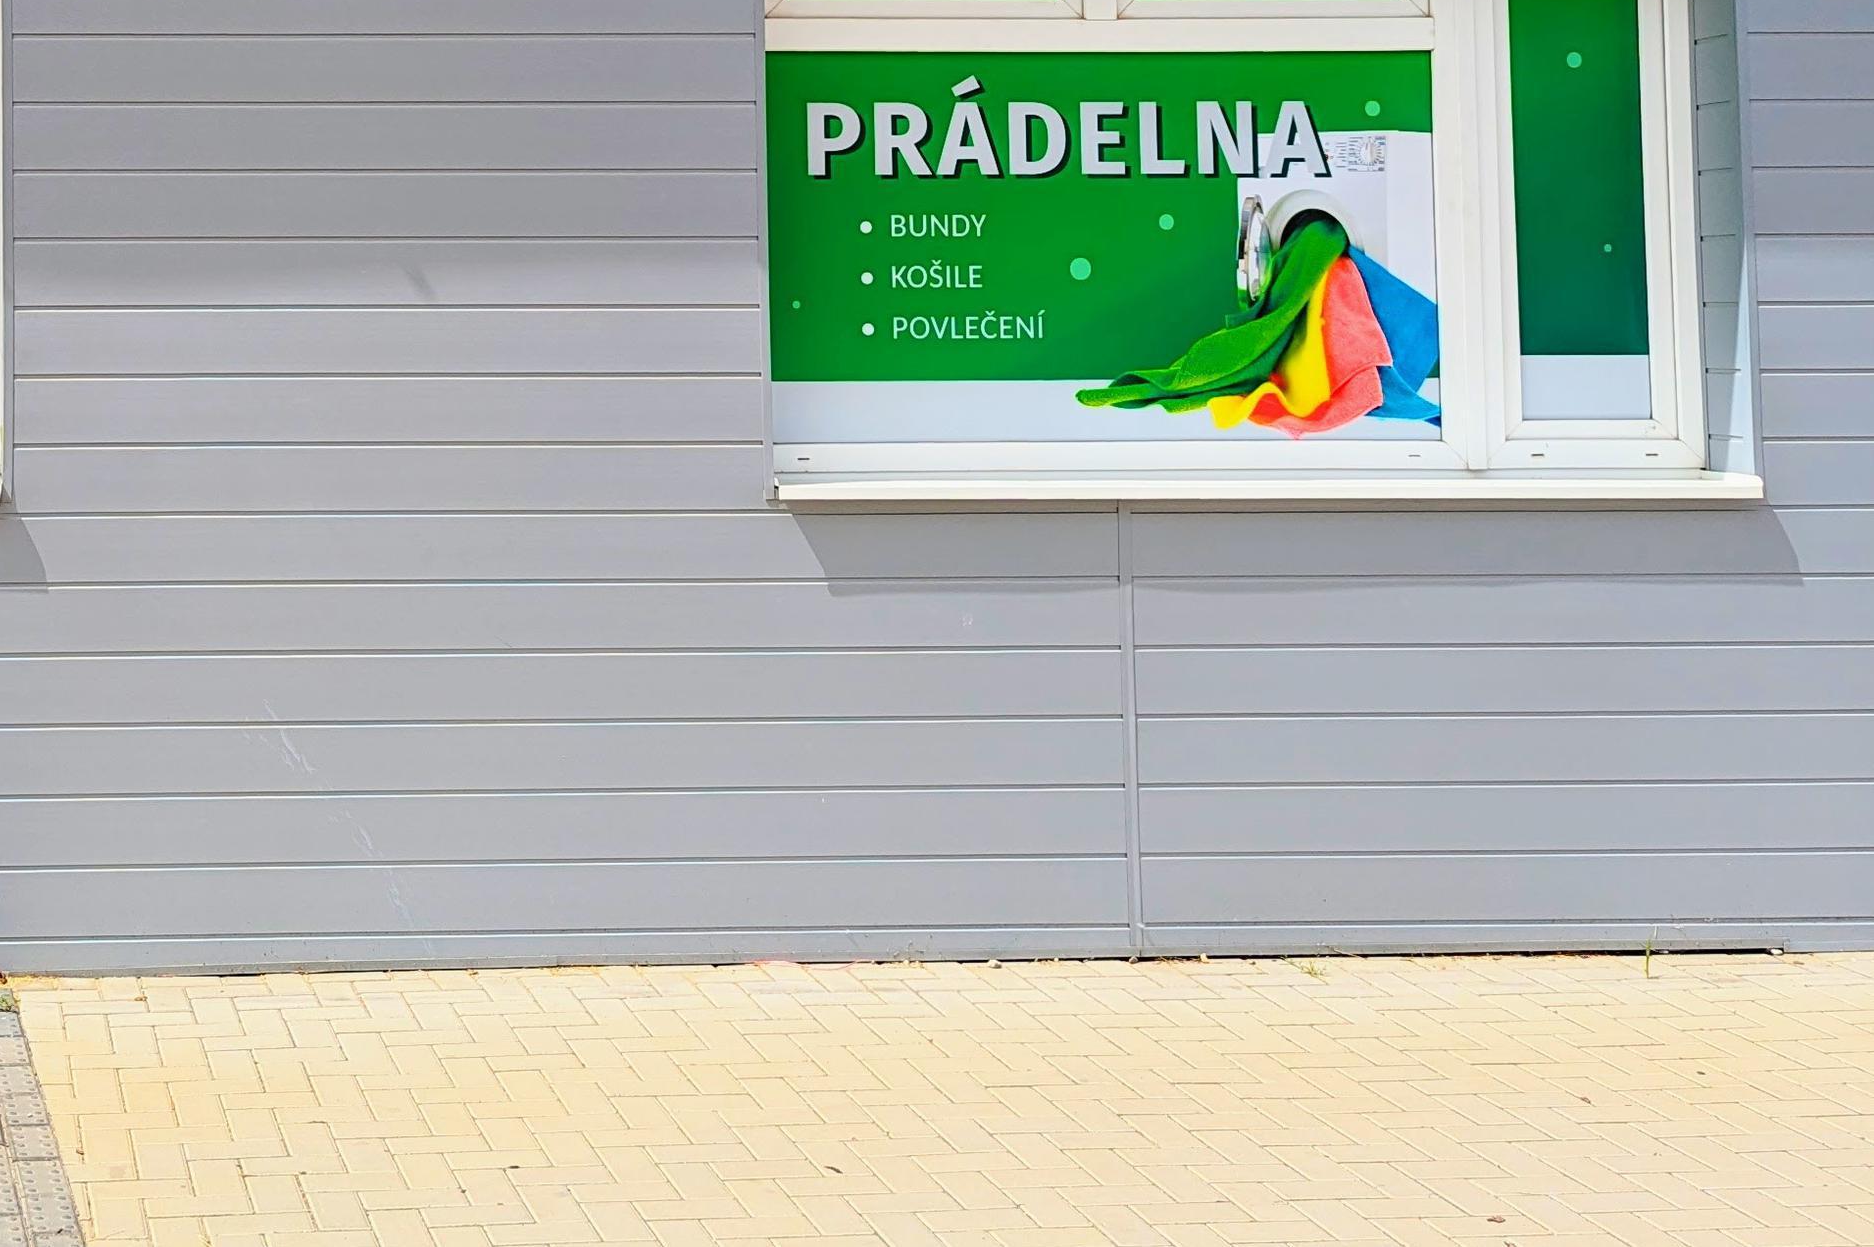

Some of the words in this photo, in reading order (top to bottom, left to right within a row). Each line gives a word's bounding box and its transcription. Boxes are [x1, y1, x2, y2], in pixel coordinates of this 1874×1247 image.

[805, 76, 1331, 179] PRÁDELNA
[890, 213, 987, 239] BUNDY
[890, 259, 984, 290] KOŠILE
[891, 309, 1046, 341] POVLEČENÍ
